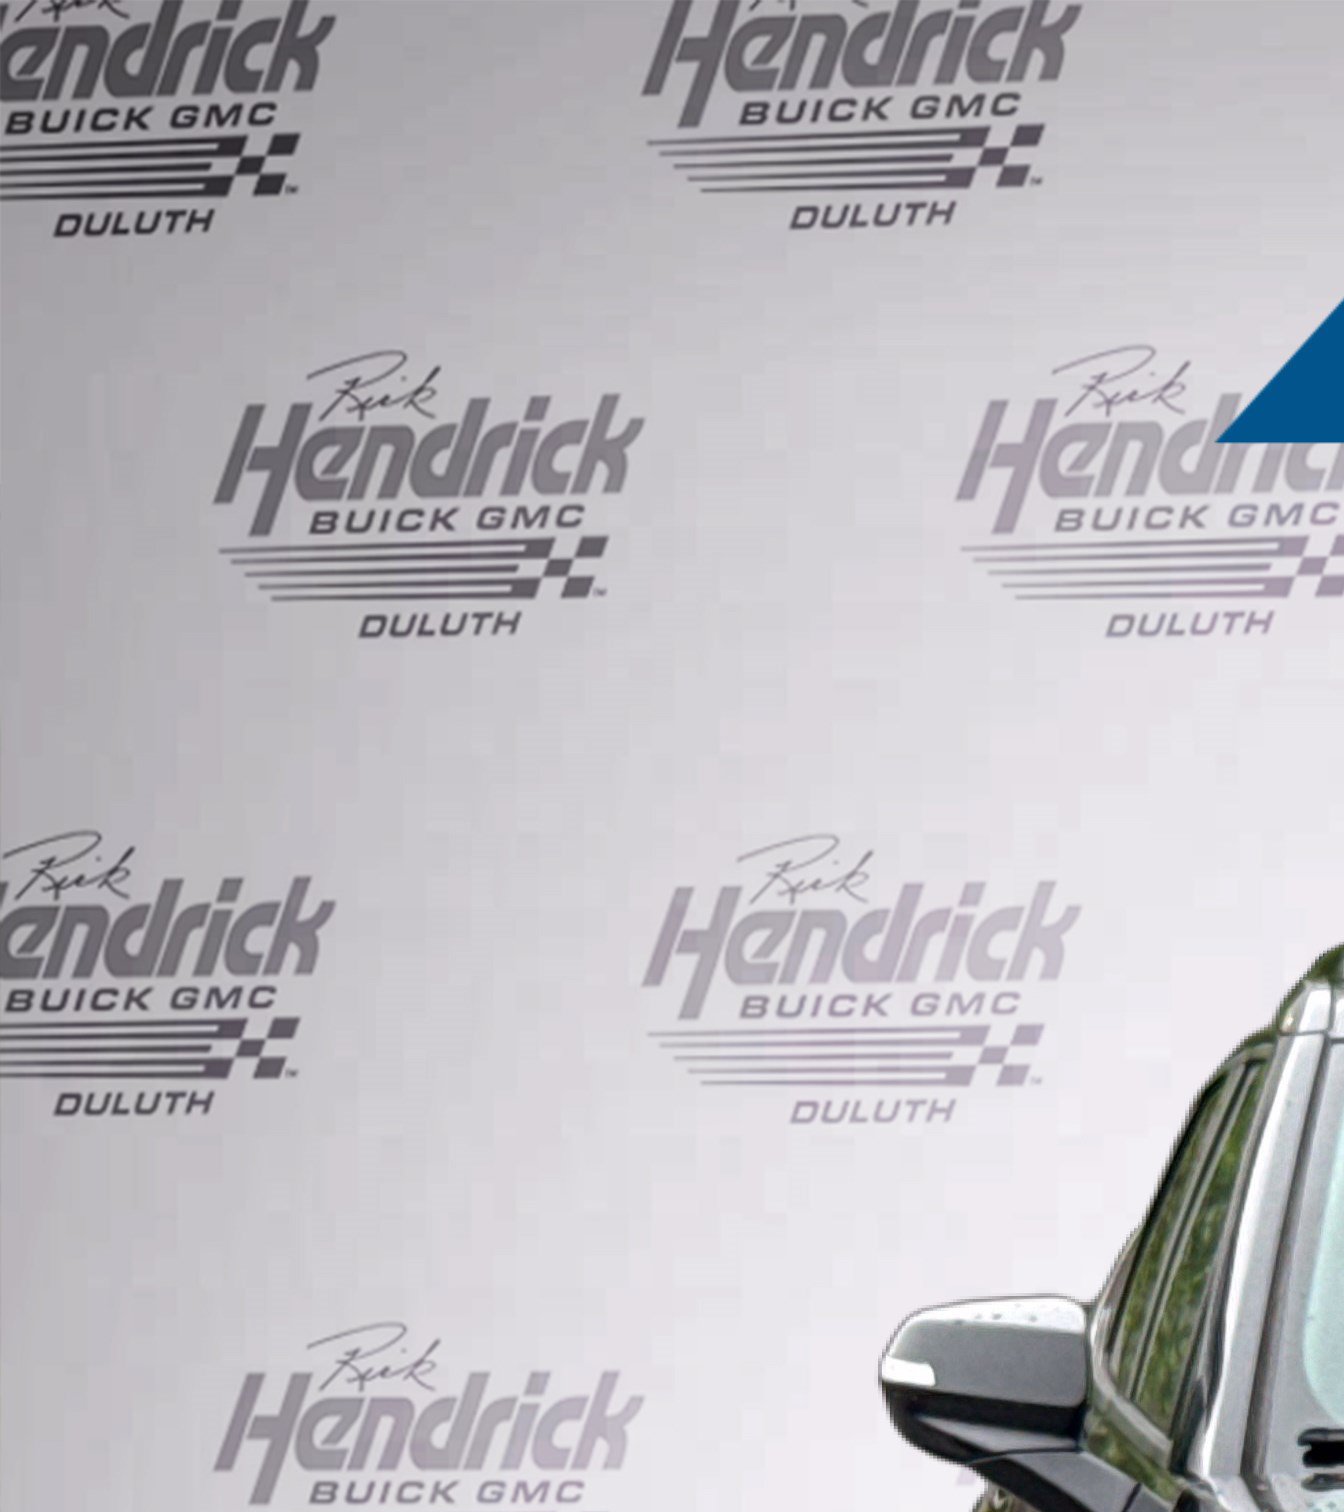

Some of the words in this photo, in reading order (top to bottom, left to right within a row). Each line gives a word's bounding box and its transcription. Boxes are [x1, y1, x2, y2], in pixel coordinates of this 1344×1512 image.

[0, 0, 336, 101] endrick
[641, 0, 1082, 128] Hendrick
[4, 106, 153, 135] BUICK
[170, 102, 277, 129] GMC
[738, 97, 892, 125] BUICK
[910, 93, 1022, 119] GMC
[53, 209, 215, 238] DULUTH
[789, 201, 956, 230] DULUTH
[212, 393, 645, 537] Hendrick
[308, 508, 459, 535] BUICK
[476, 504, 586, 531] GMC
[1054, 505, 1210, 533] BUICK
[1228, 501, 1340, 528] GMC
[358, 611, 522, 640] DULUTH
[1105, 610, 1275, 639] DULUTH
[0, 875, 336, 980] endrick
[641, 880, 1082, 1020] Hendrick
[4, 988, 153, 1013] BUICK
[169, 985, 278, 1010] GMC
[739, 993, 893, 1019] BUICK
[909, 991, 1022, 1016] GMC
[53, 1091, 215, 1117] DULUTH
[789, 1099, 956, 1124] DULUTH
[212, 1370, 645, 1505] Hendrick
[308, 1481, 459, 1505] BUICK
[476, 1480, 586, 1504] GMC
